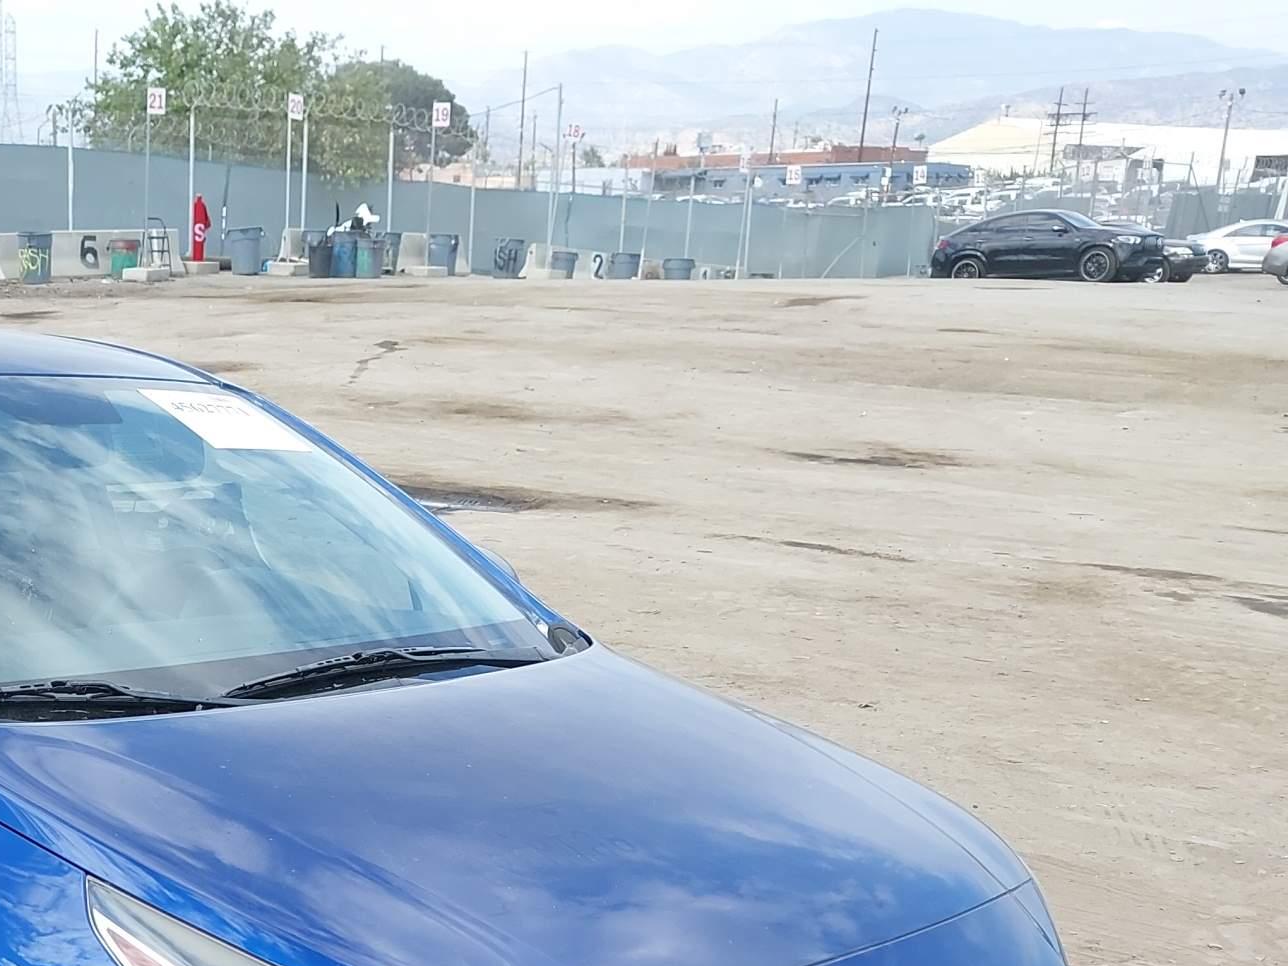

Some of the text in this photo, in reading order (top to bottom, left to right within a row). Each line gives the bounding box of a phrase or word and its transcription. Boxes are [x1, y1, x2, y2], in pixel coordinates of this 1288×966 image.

[149, 92, 163, 109] 21
[290, 99, 303, 114] 20
[434, 107, 449, 122] 19
[80, 235, 99, 270] 6
